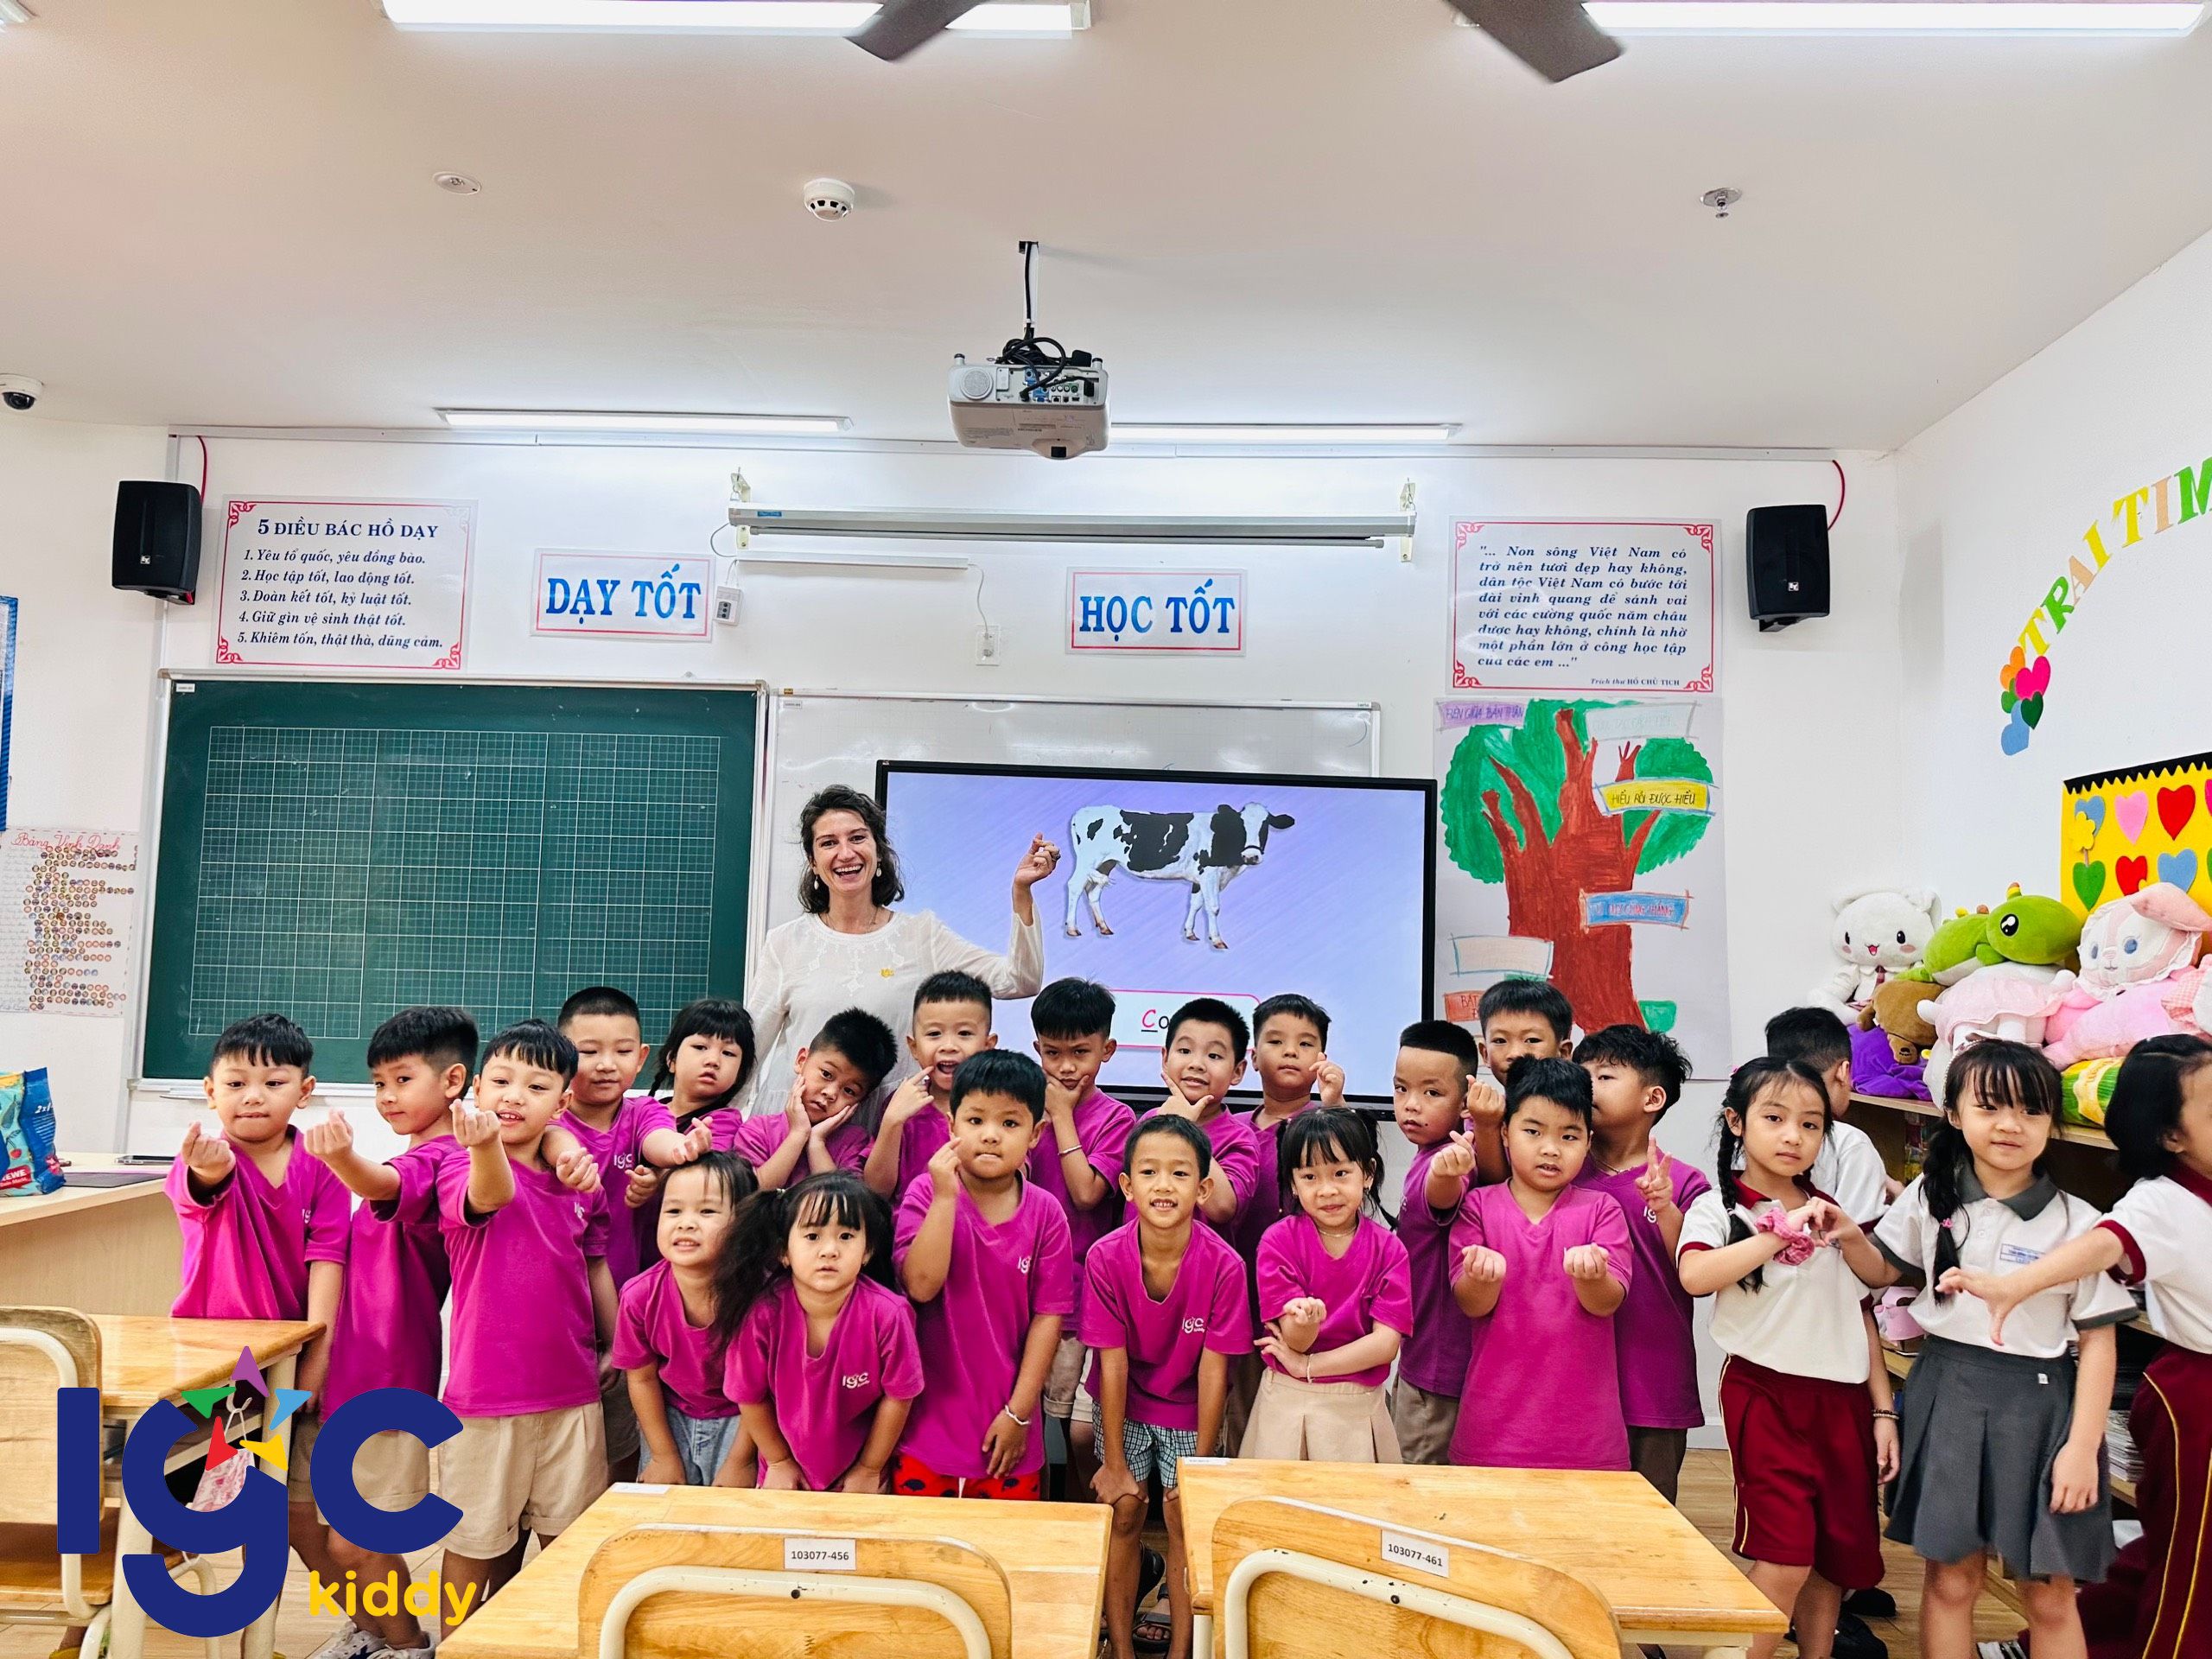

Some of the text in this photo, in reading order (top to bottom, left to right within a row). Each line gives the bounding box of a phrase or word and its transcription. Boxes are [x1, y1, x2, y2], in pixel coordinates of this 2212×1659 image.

[257, 516, 439, 541] 5 ĐIỀU BÁC HỒ DẠY
[244, 549, 253, 561] 1.
[257, 549, 280, 561] Yêu
[284, 548, 299, 561] tổ
[301, 549, 333, 563] quốc,
[336, 550, 359, 564] yêu
[399, 551, 425, 564] bào.
[1507, 546, 1535, 556] Non
[1546, 546, 1578, 559] sông
[1590, 546, 1618, 559] Việt
[1628, 546, 1661, 557] Nam
[1672, 549, 1687, 559] có
[241, 569, 251, 581] 2.
[254, 569, 279, 583] Học
[283, 570, 304, 584] tập
[308, 569, 329, 584] tốt,
[334, 570, 354, 583] lao
[394, 570, 415, 584] tốt.
[1479, 561, 1501, 571] trở
[1507, 562, 1533, 571] nên
[1541, 562, 1567, 572] tươi
[1608, 562, 1633, 575] hay
[1640, 563, 1687, 576] không,
[1479, 576, 1687, 589] dân tộc Việt Nam có bước tới
[2018, 519, 2113, 657] TRAI
[240, 588, 411, 607] 3. Đoàn kết tốt, kỷ luật tốt.
[545, 563, 702, 625] DẠY TỐT
[1510, 593, 1540, 603] vinh
[1548, 595, 1592, 606] quang
[1624, 594, 1657, 605] sánh
[1667, 595, 1687, 605] vai
[1079, 578, 1236, 642] HỌC TỐT
[1478, 607, 1687, 622] với các cường quốc năm châu
[238, 610, 405, 627] 4. Giữ gìn vệ sinh thật tốt.
[1516, 624, 1540, 637] hay
[1545, 625, 1592, 638] không,
[1597, 625, 1637, 637] chính
[1642, 626, 1656, 637] là
[1660, 626, 1688, 638] nhờ
[238, 631, 443, 649] 5. Khiêm tốn, thật thà, dũng cảm.
[1478, 639, 1504, 652] một
[1509, 639, 1544, 652] phần
[1551, 640, 1573, 652] lớn
[1594, 641, 1628, 654] công
[1633, 641, 1658, 654] học
[1663, 643, 1687, 656] tập
[1507, 656, 1530, 667] các
[1534, 658, 1554, 667] em
[1141, 1009, 1169, 1029] Co
[791, 1550, 849, 1560] 103077-456
[1388, 1543, 1443, 1567] 103077-461
